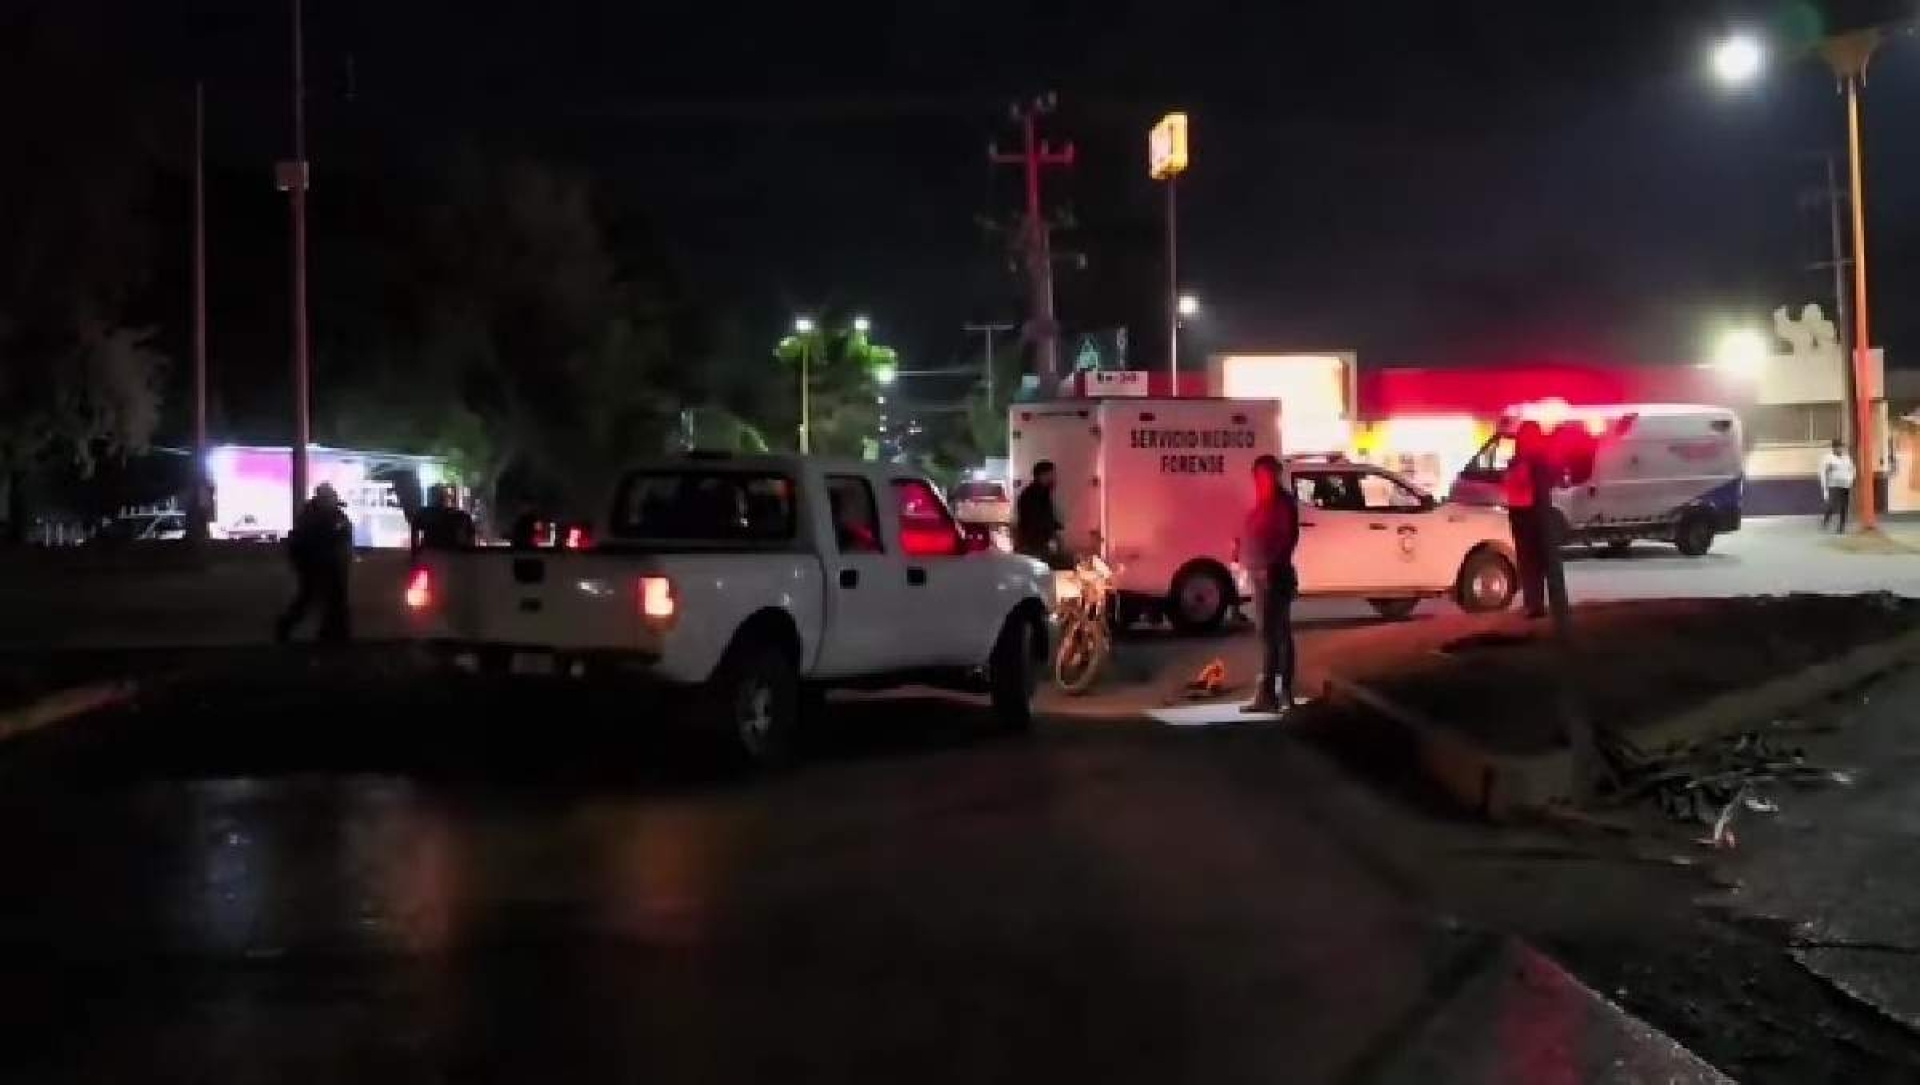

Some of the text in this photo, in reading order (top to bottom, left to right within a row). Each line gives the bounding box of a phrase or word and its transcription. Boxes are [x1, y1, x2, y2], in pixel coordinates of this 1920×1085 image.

[1130, 429, 1255, 448] SERVICIO MEDICO
[1161, 455, 1224, 473] FORENSE
